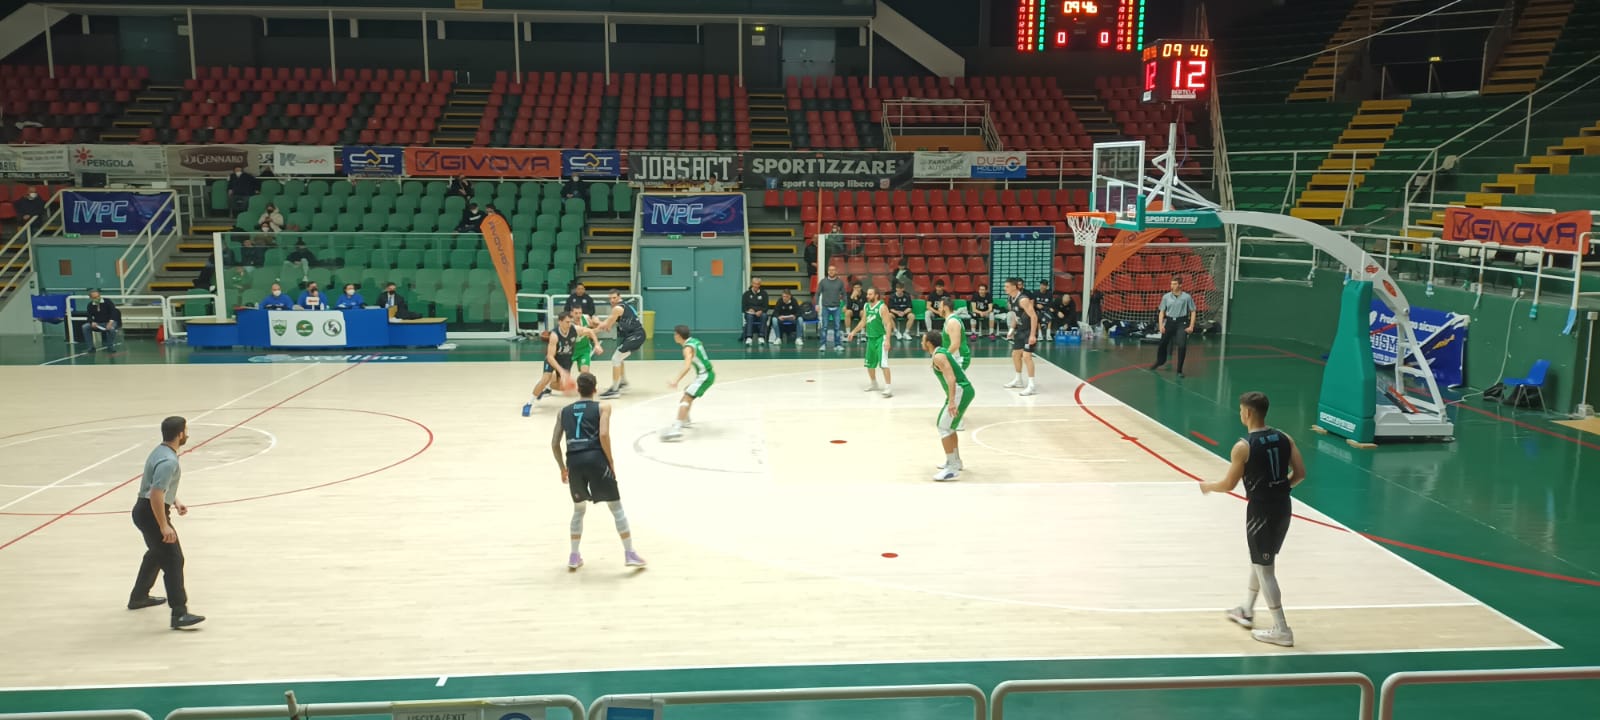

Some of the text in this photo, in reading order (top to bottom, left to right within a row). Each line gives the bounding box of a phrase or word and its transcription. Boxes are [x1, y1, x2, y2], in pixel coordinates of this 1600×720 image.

[1057, 32, 1066, 43] 0
[1100, 32, 1108, 43] 0
[1162, 44, 1182, 56] 09
[1190, 44, 1208, 57] 46
[1145, 61, 1157, 90] 12
[1175, 60, 1206, 88] 12
[86, 159, 134, 168] PERGOLA
[440, 155, 550, 170] GIVOVA
[634, 156, 732, 180] JOBSACT
[782, 180, 806, 188] sport
[816, 180, 845, 188] tempo
[847, 180, 874, 188] libero
[72, 200, 128, 223] IVPC
[651, 203, 704, 224] IVPC
[1471, 219, 1578, 245] GIVOVA
[574, 412, 584, 438] 7
[1266, 447, 1281, 480] 11
